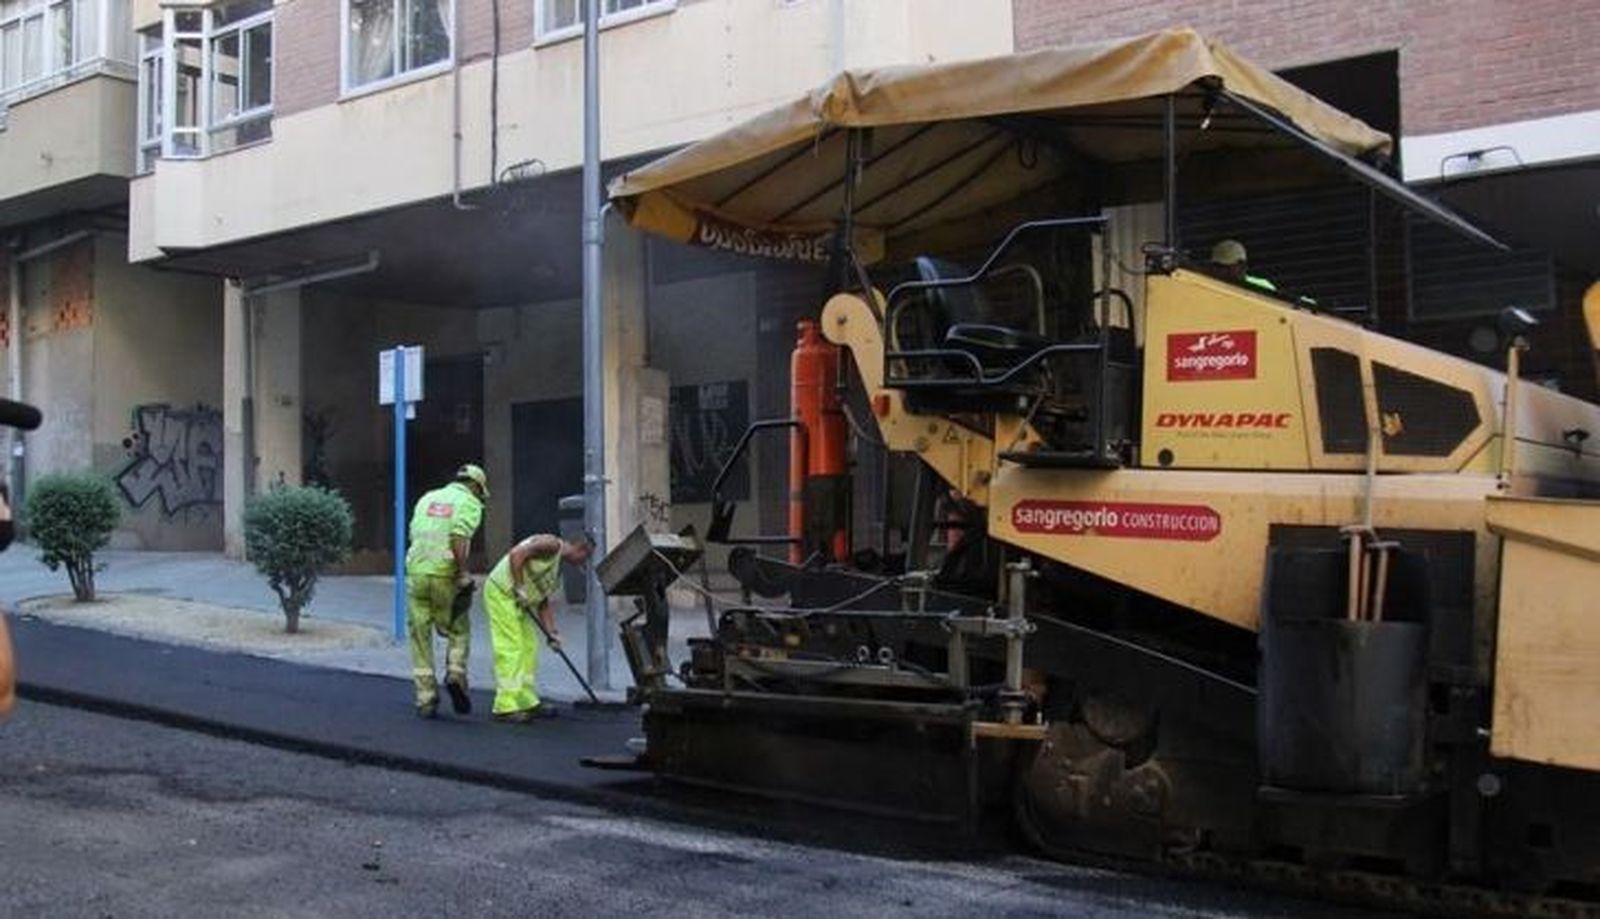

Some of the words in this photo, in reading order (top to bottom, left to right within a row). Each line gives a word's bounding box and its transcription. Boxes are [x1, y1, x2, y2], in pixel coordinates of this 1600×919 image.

[1174, 350, 1249, 370] sangregorio
[1156, 413, 1292, 428] DYNAPAC
[1015, 506, 1119, 531] sangregorio
